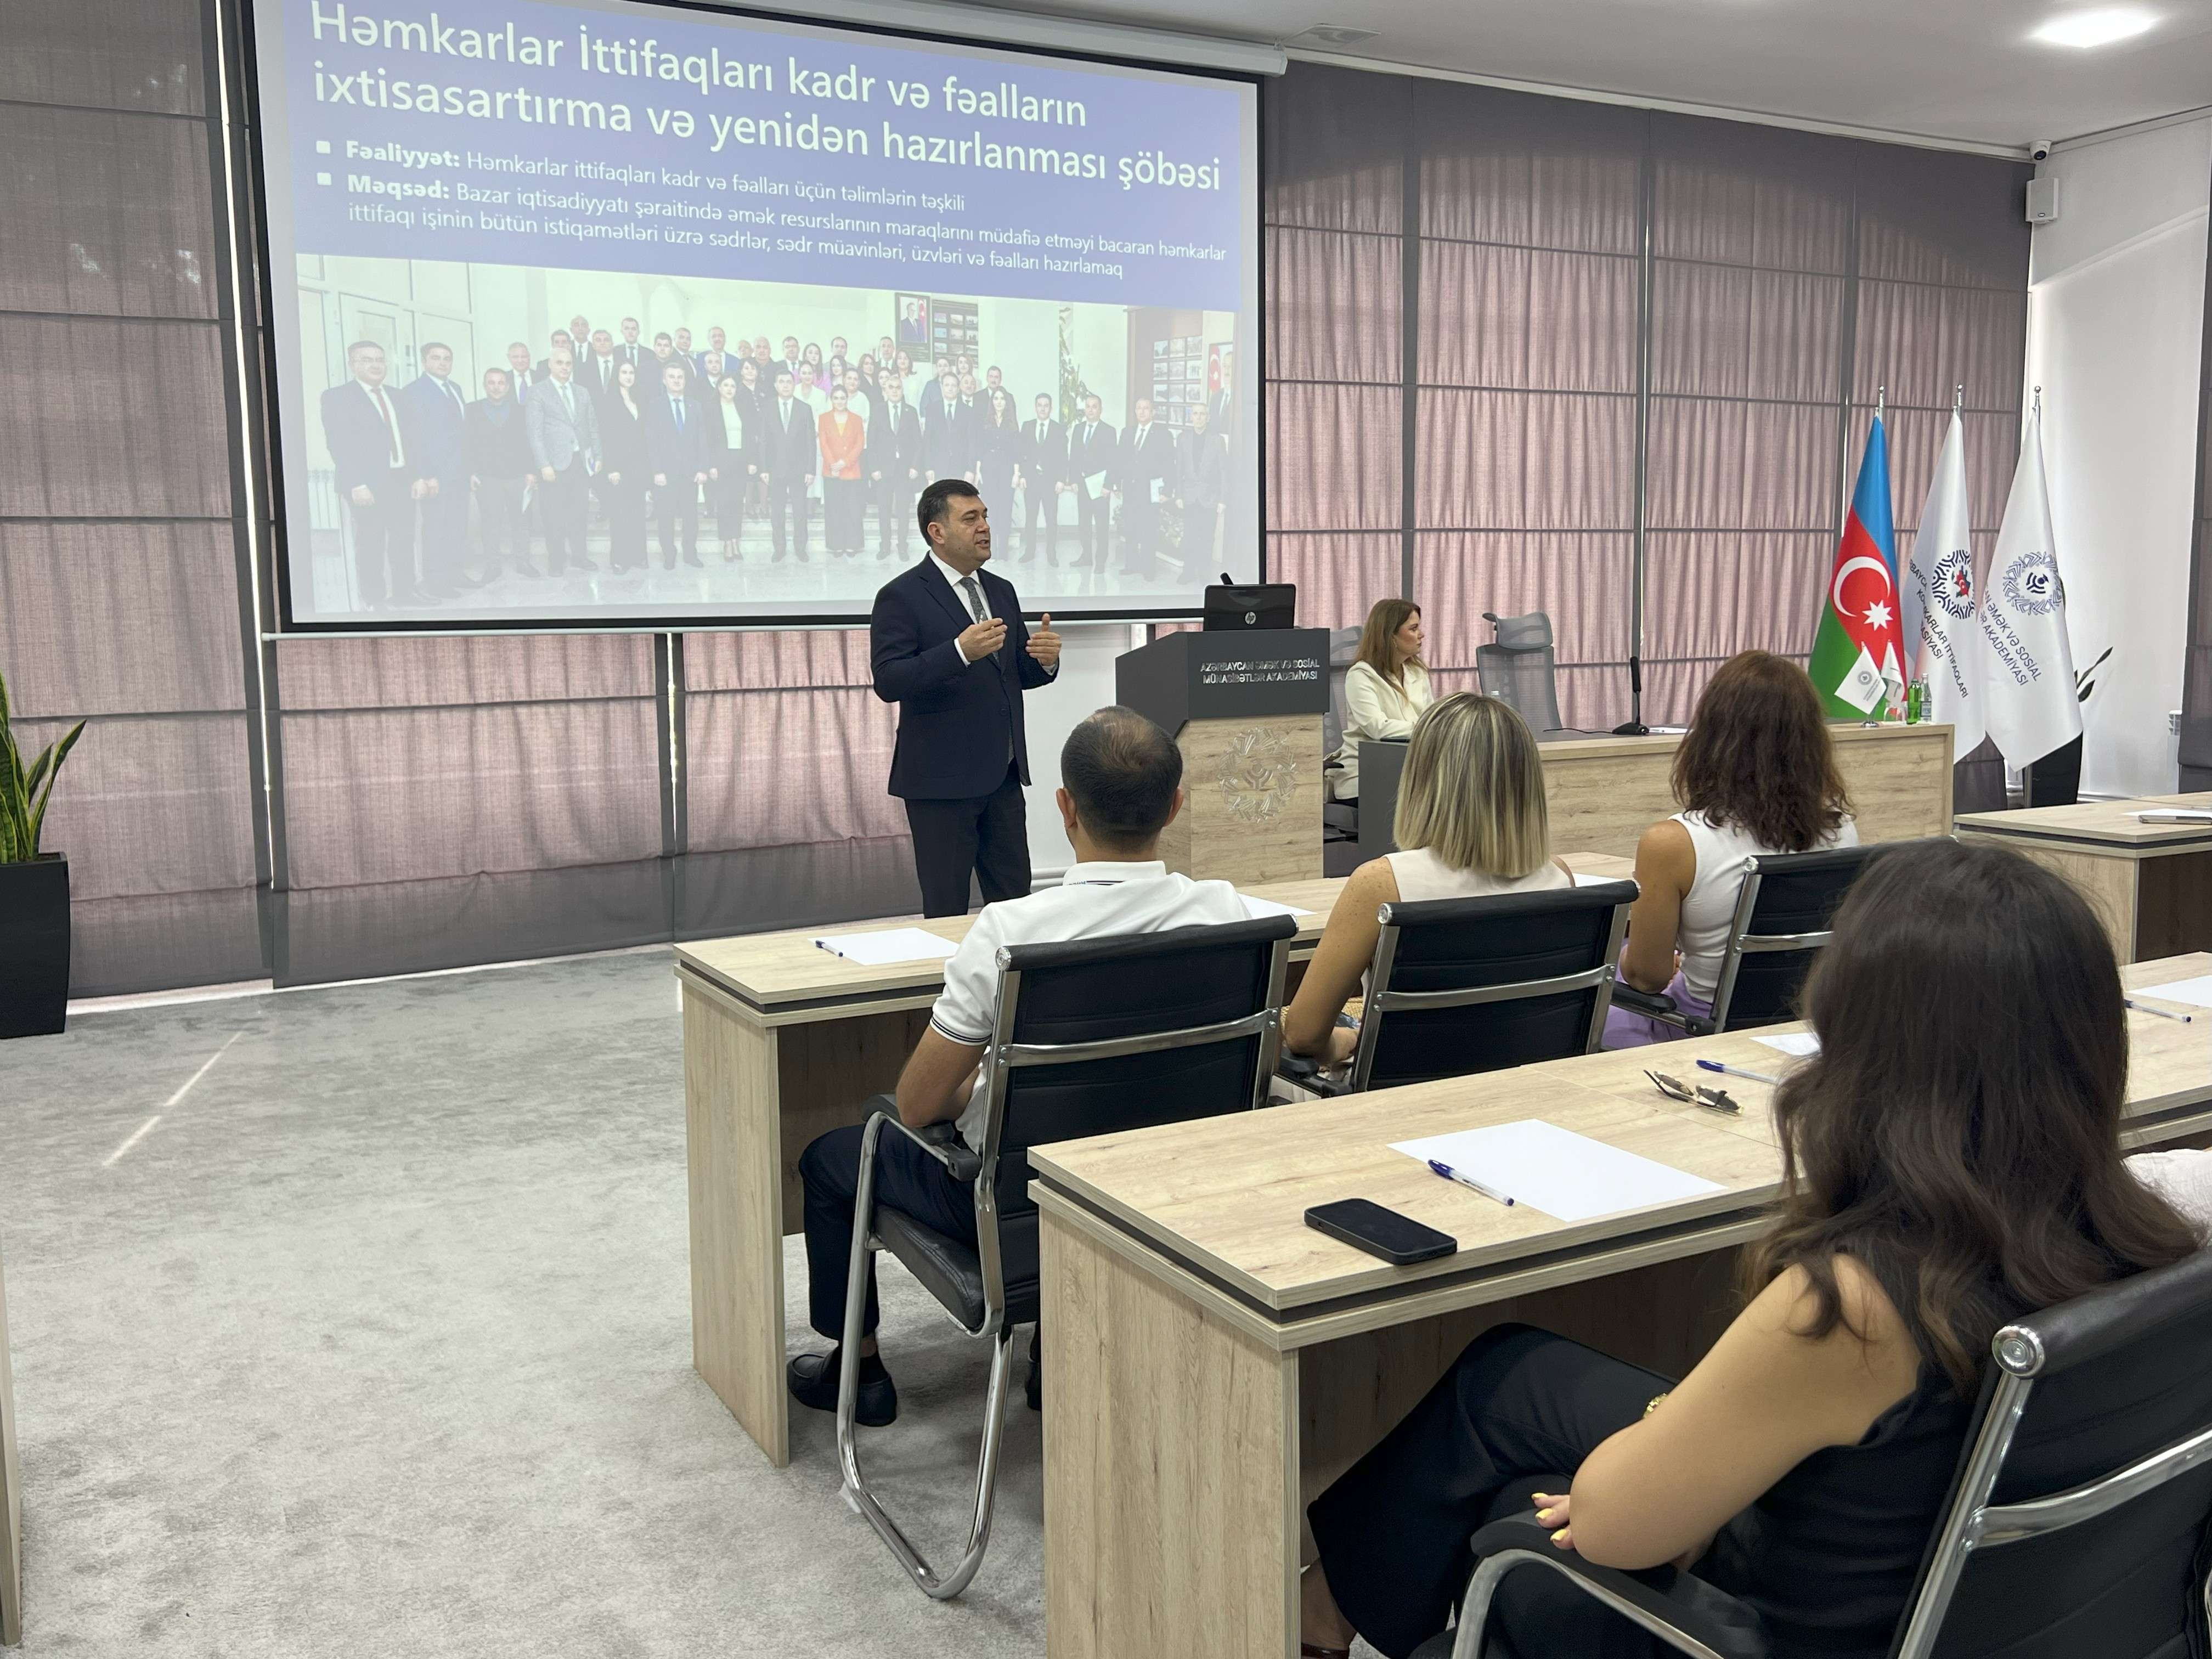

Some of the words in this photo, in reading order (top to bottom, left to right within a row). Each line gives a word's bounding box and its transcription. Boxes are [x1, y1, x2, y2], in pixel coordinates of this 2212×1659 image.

[311, 0, 564, 67] Həmkarlar
[579, 24, 772, 95] İttifaqları
[788, 57, 876, 103] kadr
[887, 80, 930, 109] və
[942, 75, 1086, 127] fəalların
[314, 60, 631, 132] ixtisasartırma
[646, 108, 695, 138] və
[708, 111, 868, 156] yenidən
[883, 121, 1105, 179] hazırlanması
[1118, 150, 1220, 190] şöbəsi
[346, 140, 460, 169] Fəaliyyət:
[467, 151, 569, 176] Həmkarlar
[575, 160, 656, 187] ittifaqları
[662, 167, 702, 188] kadr
[706, 177, 727, 190] və
[732, 174, 789, 196] fəalları
[794, 180, 836, 202] üçün
[841, 185, 916, 207] təlimlərin
[921, 193, 964, 213] təşkili
[348, 174, 449, 201] Məqsəd:
[457, 183, 511, 204] Bazar
[517, 187, 628, 216] iqtisadiyyatı
[635, 200, 723, 220] şəraitində
[727, 207, 776, 225] əmək
[781, 212, 881, 233] resurslarının
[885, 221, 973, 242] maraqlarını
[979, 228, 1041, 246] müdafiə
[1045, 233, 1094, 254] etməyi
[1099, 235, 1154, 255] bacaran
[1159, 240, 1226, 261] həmkarlar
[349, 202, 415, 229] ittifaqı
[422, 207, 473, 230] işinin
[480, 210, 538, 233] bütün
[544, 216, 658, 242] istiqamətləri
[664, 226, 703, 245] üzrə
[709, 230, 771, 252] sədrlər,
[776, 235, 814, 253] sədr
[818, 239, 906, 263] müavinləri,
[912, 245, 962, 264] üzvləri
[966, 253, 985, 266] və
[989, 250, 1039, 270] fəalları
[1044, 254, 1122, 280] hazırlamaq
[1245, 612, 1256, 624] hp
[1988, 603, 2011, 633] ƏMƏK
[2006, 631, 2019, 646] VƏ
[2016, 646, 2041, 681] SOSİAL
[1200, 661, 1254, 672] AZƏRBAYCAN
[1293, 658, 1320, 668] SOSİAL
[1266, 670, 1317, 681] AKADEMİYASI
[1945, 642, 1968, 698] İTTİFAQLARI
[1983, 625, 2029, 686] AKADEMİYASI
